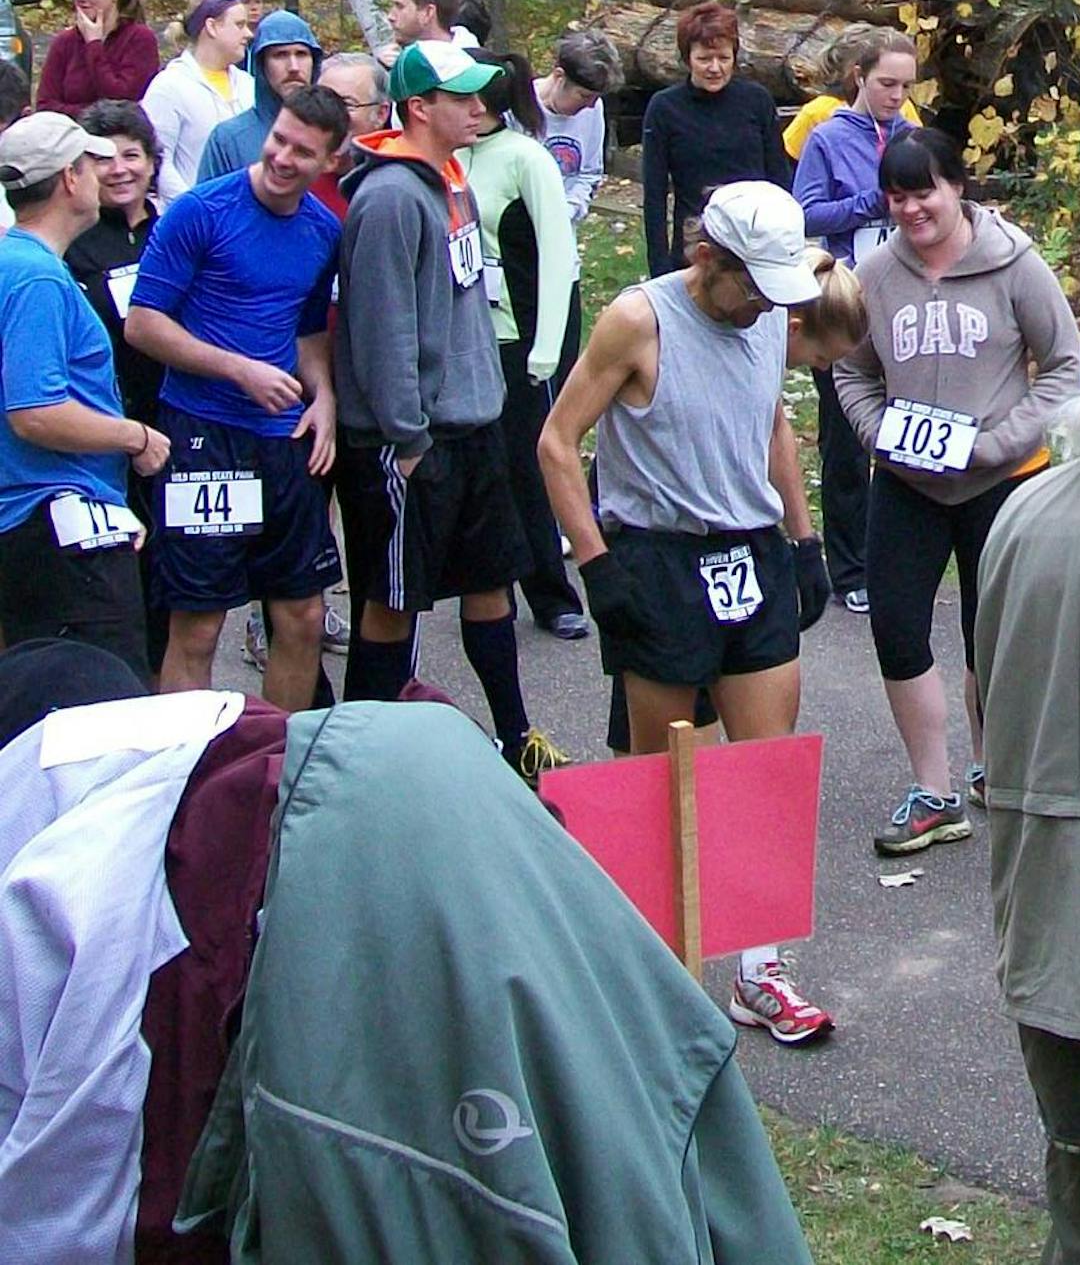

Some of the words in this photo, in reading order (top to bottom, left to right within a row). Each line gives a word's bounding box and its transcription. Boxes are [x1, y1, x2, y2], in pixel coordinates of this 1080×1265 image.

[459, 236, 473, 274] 40
[892, 300, 988, 362] GAP
[893, 414, 952, 460] 103
[193, 483, 232, 523] 44
[711, 561, 755, 609] 52
